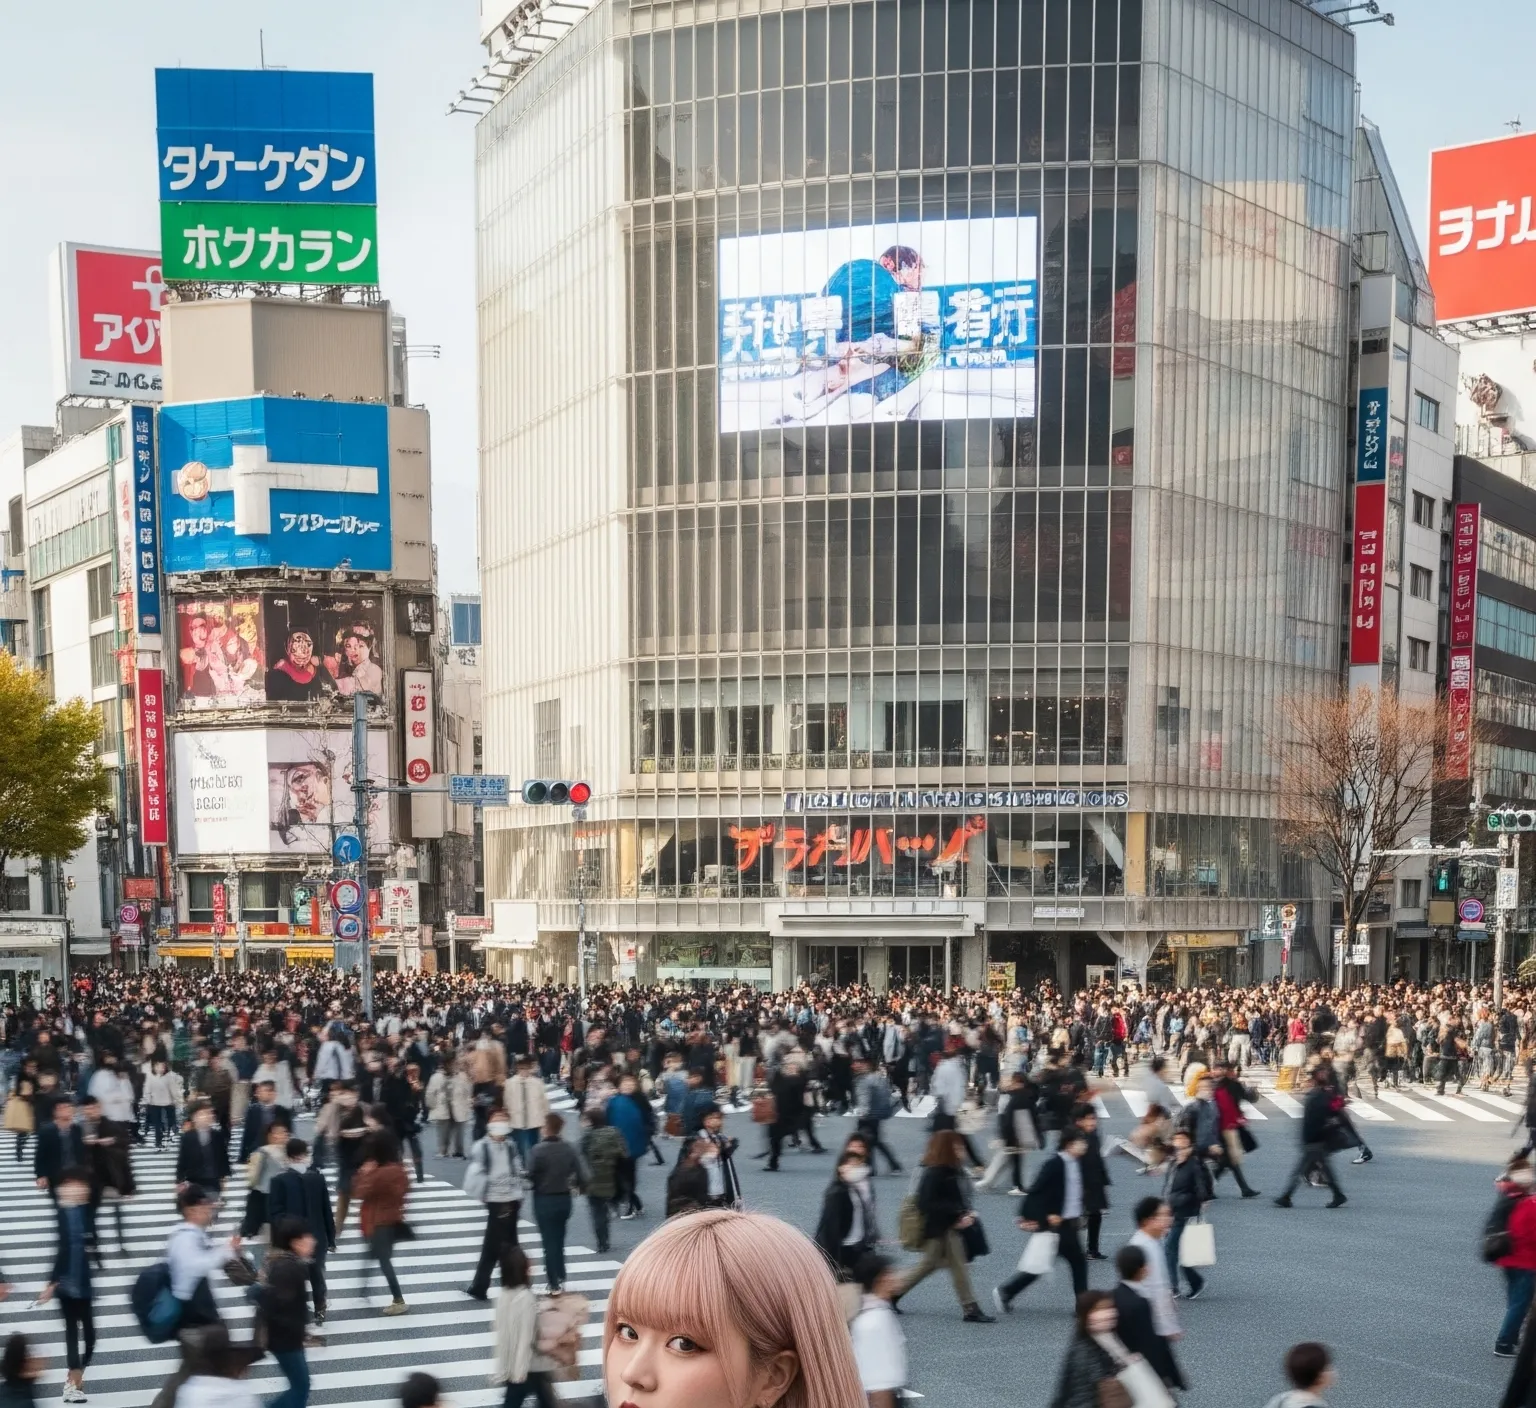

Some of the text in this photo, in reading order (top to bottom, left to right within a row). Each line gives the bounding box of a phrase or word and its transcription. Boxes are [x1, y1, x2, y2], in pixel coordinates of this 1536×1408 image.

[182, 223, 372, 273] ホクカラン
